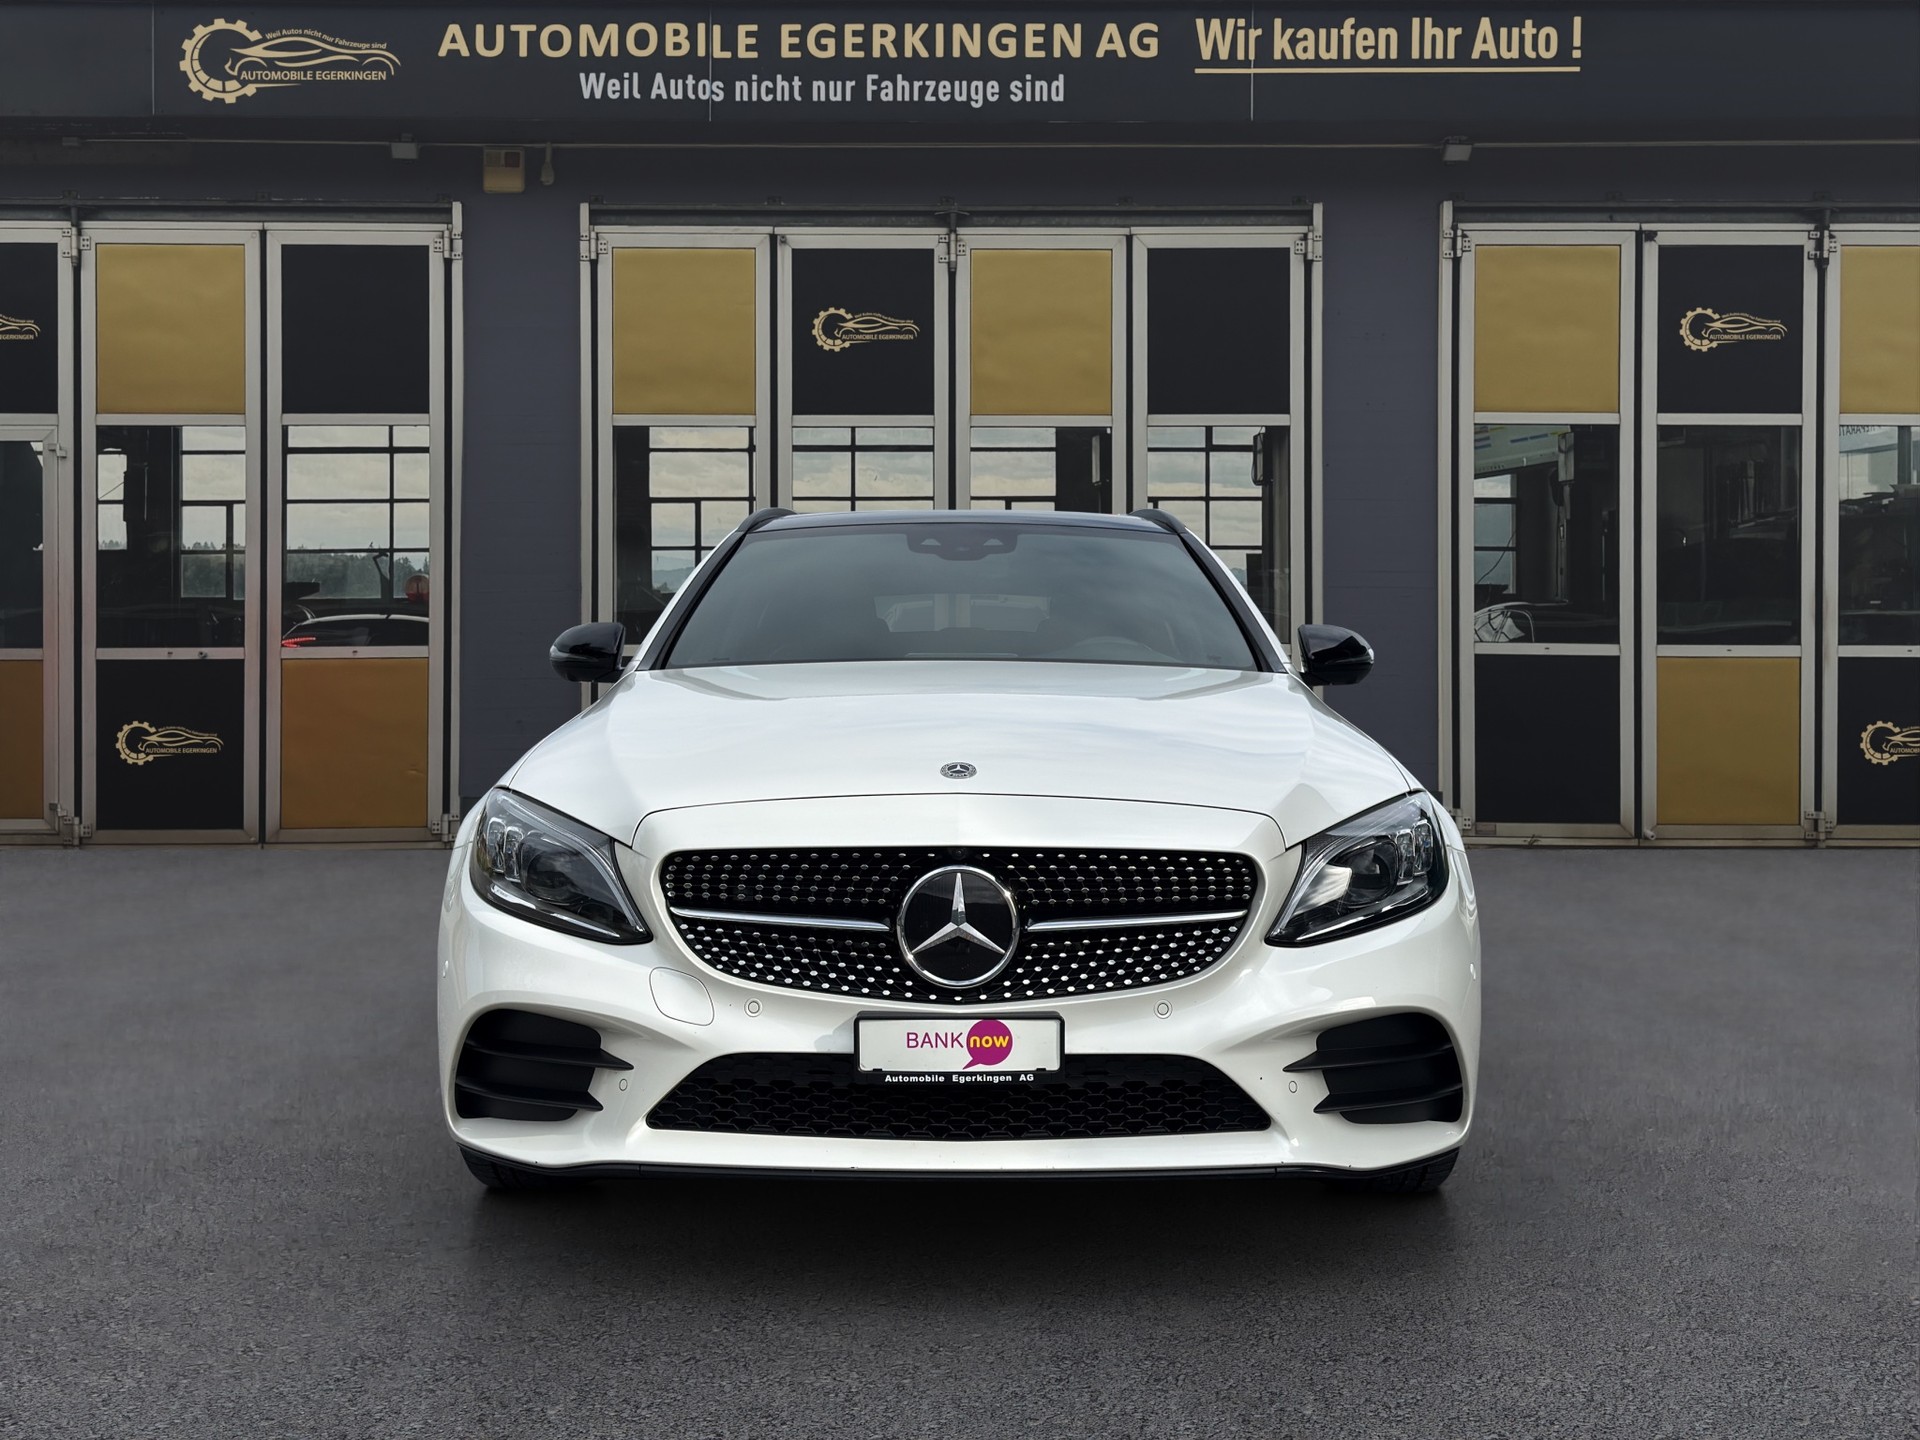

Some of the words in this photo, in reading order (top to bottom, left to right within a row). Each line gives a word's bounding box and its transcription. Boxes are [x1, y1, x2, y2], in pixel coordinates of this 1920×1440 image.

[265, 30, 281, 40] Weil
[282, 28, 302, 36] Autos
[303, 29, 321, 38] nicht
[322, 34, 335, 42] nur
[335, 37, 370, 49] Fahrzeuge
[437, 22, 759, 59] AUTOMOBILE
[780, 22, 1082, 59] EGERKINGEN
[1095, 22, 1159, 59] AG
[1195, 17, 1262, 61] Wir
[1273, 17, 1398, 61] kaufen
[1411, 16, 1462, 60] Ihr
[1470, 16, 1559, 60] Auto
[240, 70, 313, 81] AUTOMOBILE
[315, 70, 387, 81] EGERKINGEN
[579, 72, 641, 100] Weil
[650, 72, 725, 101] Autos
[734, 74, 802, 102] nicht
[811, 80, 856, 102] nur
[866, 74, 1000, 109] Fahrzeuge
[1009, 74, 1065, 102] sind
[906, 1031, 964, 1049] BANK
[969, 1035, 1010, 1048] now
[884, 1074, 945, 1083] Automobile
[952, 1074, 1012, 1084] Egerkingen
[1019, 1073, 1035, 1082] AG
